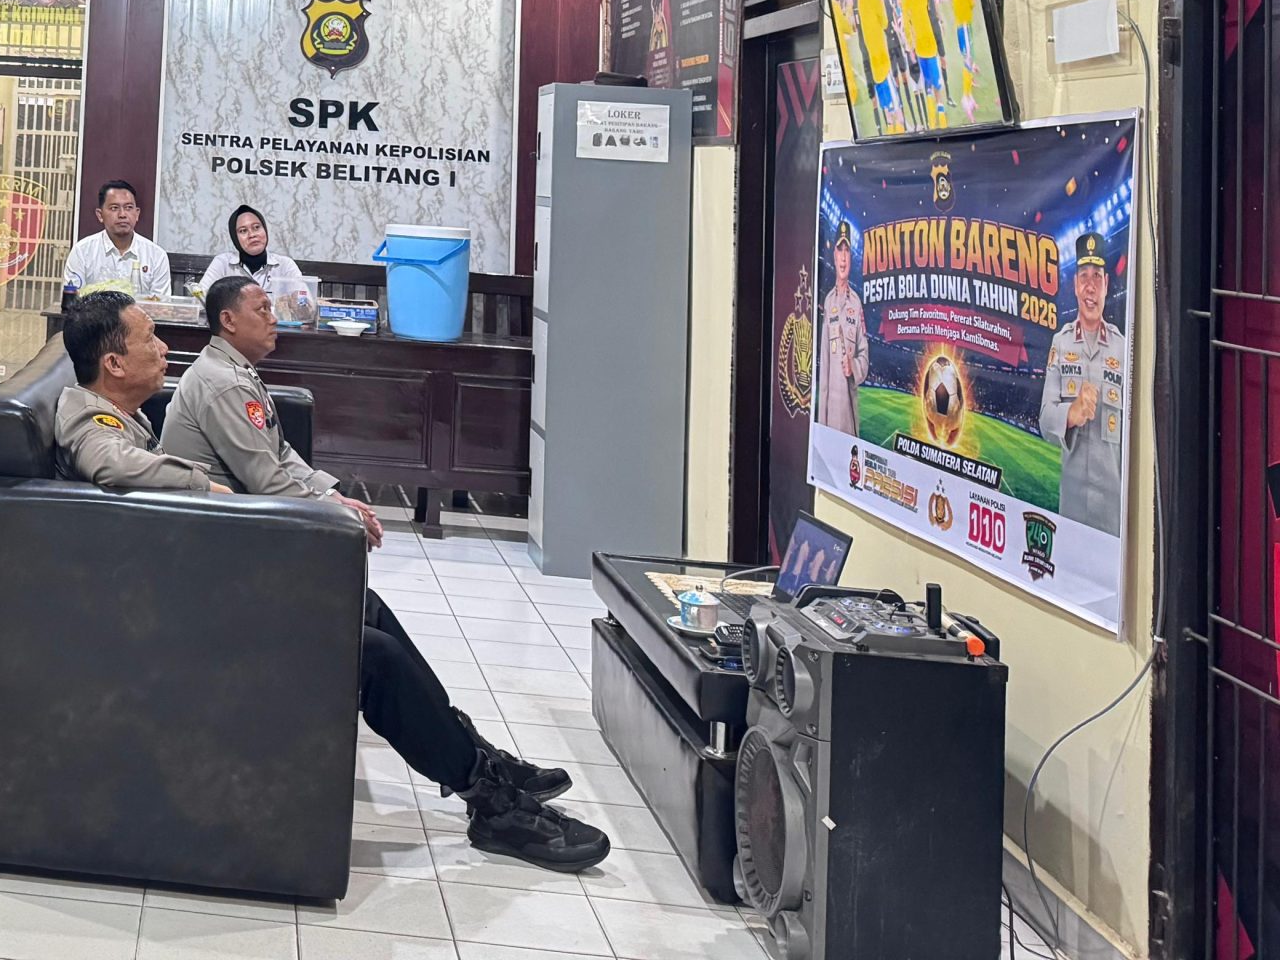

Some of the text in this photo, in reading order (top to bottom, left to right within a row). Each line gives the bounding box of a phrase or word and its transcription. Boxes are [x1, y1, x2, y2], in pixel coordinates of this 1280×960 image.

[11, 5, 81, 24] KRIMINAL
[288, 98, 380, 132] SPK
[608, 110, 641, 120] LOKER
[181, 133, 490, 163] SENTRA PELAYANAN KEPOLISIAN
[212, 157, 456, 187] POLSEK BELITANG I
[863, 217, 1059, 296] NONTON BARENG
[863, 274, 1057, 330] PESTA BOLA DUNIA TAHUN 2026
[888, 309, 909, 320] Dukung
[909, 308, 919, 319] Tim
[950, 311, 972, 326] Pererat
[897, 324, 920, 335] Bersama
[920, 324, 934, 334] Polri
[934, 325, 960, 340] Menjaga
[898, 437, 920, 456] POLDA
[921, 444, 961, 472] SUMATERA
[962, 460, 998, 485] SELATAN
[864, 467, 918, 508] PRESISI
[969, 491, 1006, 512] LAYANAN POLISI
[970, 506, 1005, 551] 110
